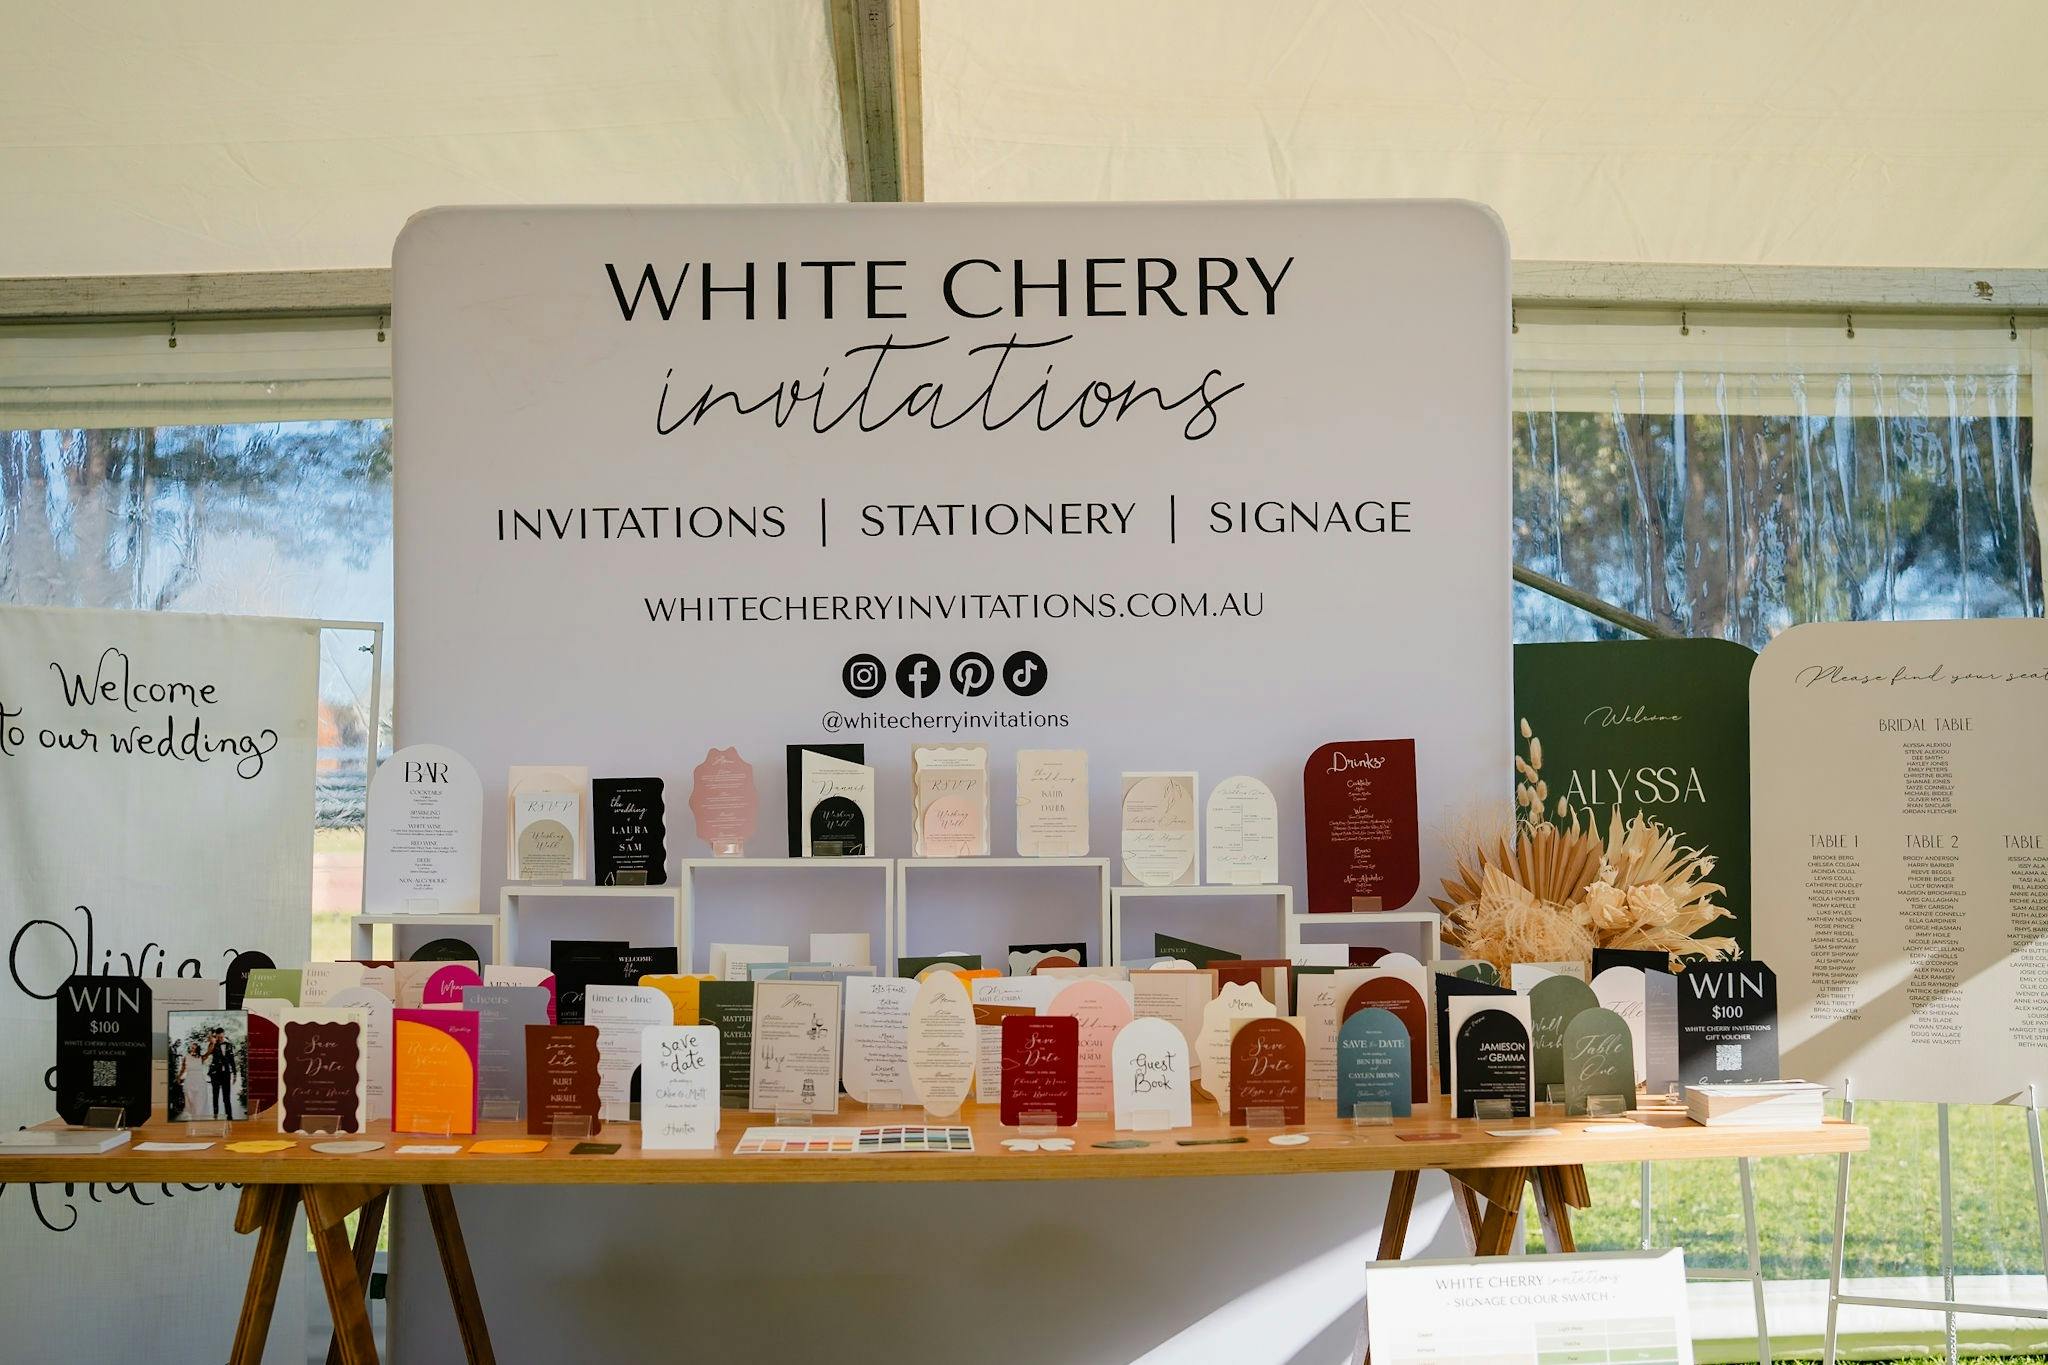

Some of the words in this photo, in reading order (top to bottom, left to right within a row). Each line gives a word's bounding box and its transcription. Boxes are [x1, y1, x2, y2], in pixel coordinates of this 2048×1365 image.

[605, 260, 909, 323] WHITE
[942, 256, 1296, 319] CHERRY
[655, 332, 1246, 442] invitations
[498, 508, 786, 541] INVITATIONS
[860, 503, 1137, 538] STATIONERY
[1211, 500, 1413, 535] SIGNAGE
[644, 593, 1266, 622] WHITECHERRYINVITATIONS.COM.AU
[50, 647, 219, 713] Welcome
[1794, 664, 1888, 689] Please
[1893, 663, 1947, 688] find
[1950, 670, 2003, 689] your
[822, 709, 1070, 732] @whitecherryinvitations
[1583, 704, 1684, 728] Welcome
[1878, 718, 1926, 732] BRIDAL
[1934, 717, 1974, 732] TABLE
[0, 703, 25, 757] to
[38, 726, 99, 753] our
[111, 715, 279, 780] wedding
[405, 762, 448, 783] BAR
[1327, 752, 1386, 774] Drinks
[1564, 766, 1707, 805] ALYSSA
[610, 795, 624, 808] the
[614, 802, 648, 820] wedding
[612, 826, 648, 835] LAURA
[619, 843, 642, 852] SAM
[1808, 834, 1848, 848] TABLE
[1853, 834, 1859, 848] 1
[1904, 834, 1944, 848] TABLE
[1951, 835, 1959, 848] 2
[2002, 835, 2043, 849] TABLE
[1688, 972, 1764, 999] WIN
[68, 986, 140, 1014] WIN
[592, 994, 614, 1003] time
[616, 994, 628, 1003] to
[630, 994, 652, 1004] dine
[1228, 999, 1254, 1011] Menu
[1711, 1006, 1743, 1020] $100
[90, 1020, 120, 1034] $100
[304, 1034, 338, 1054] Save
[662, 1034, 698, 1057] save
[1025, 1032, 1056, 1050] Save
[1248, 1036, 1287, 1057] Save
[1342, 1040, 1368, 1048] SAVE
[1379, 1040, 1405, 1048] DATE
[1480, 1042, 1526, 1051] JAMIESON
[1571, 1034, 1623, 1061] Table
[296, 1057, 344, 1077] Date
[671, 1050, 705, 1074] date
[1016, 1050, 1062, 1067] Date
[1130, 1050, 1177, 1076] Guest
[1240, 1056, 1294, 1076] Date
[1488, 1053, 1526, 1062] GEMMA
[1579, 1054, 1616, 1082] One
[1134, 1069, 1172, 1094] Book
[1436, 1276, 1484, 1290] WHITE
[1488, 1274, 1544, 1289] CHERRY
[1454, 1296, 1508, 1308] SIGNAGE
[1509, 1294, 1558, 1306] COLOUR
[1560, 1291, 1609, 1303] SWATCH
